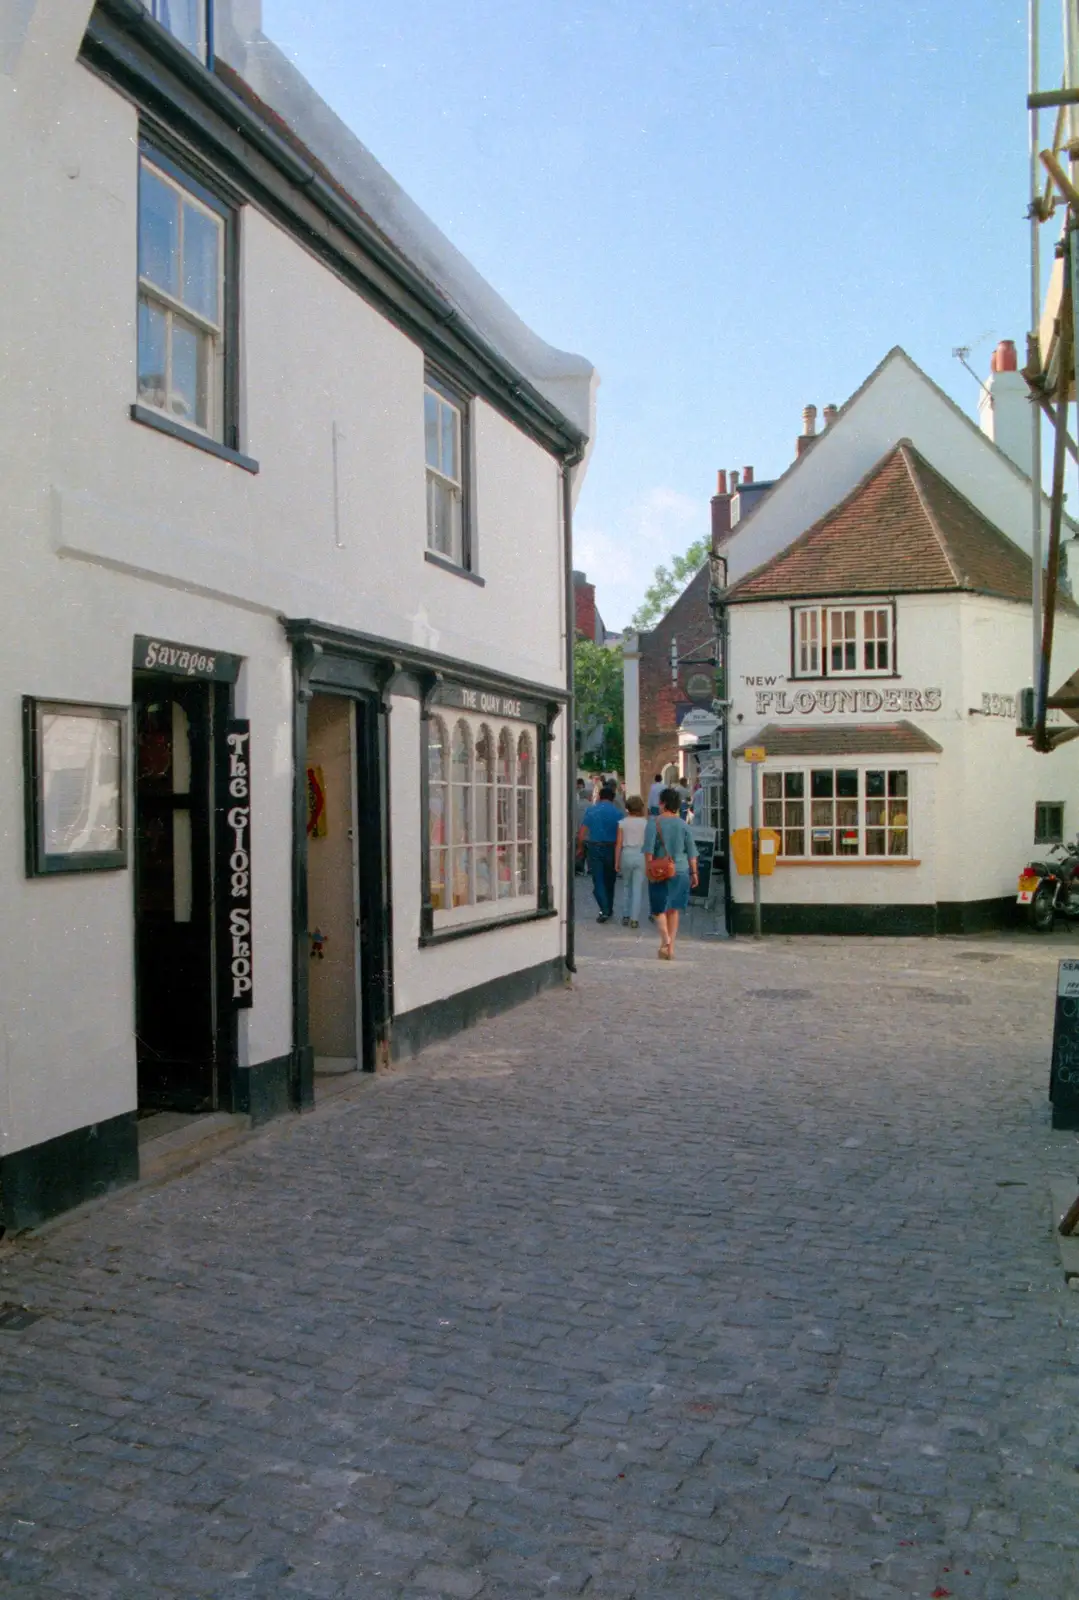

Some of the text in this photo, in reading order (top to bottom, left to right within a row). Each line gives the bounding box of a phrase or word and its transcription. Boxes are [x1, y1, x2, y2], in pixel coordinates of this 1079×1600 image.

[145, 641, 215, 676] Savages
[461, 689, 521, 717] THE QUAY HOLE
[755, 687, 942, 715] FLOUNDERS
[227, 732, 249, 798] The
[1021, 891, 1028, 901] L
[229, 908, 252, 998] Shop
